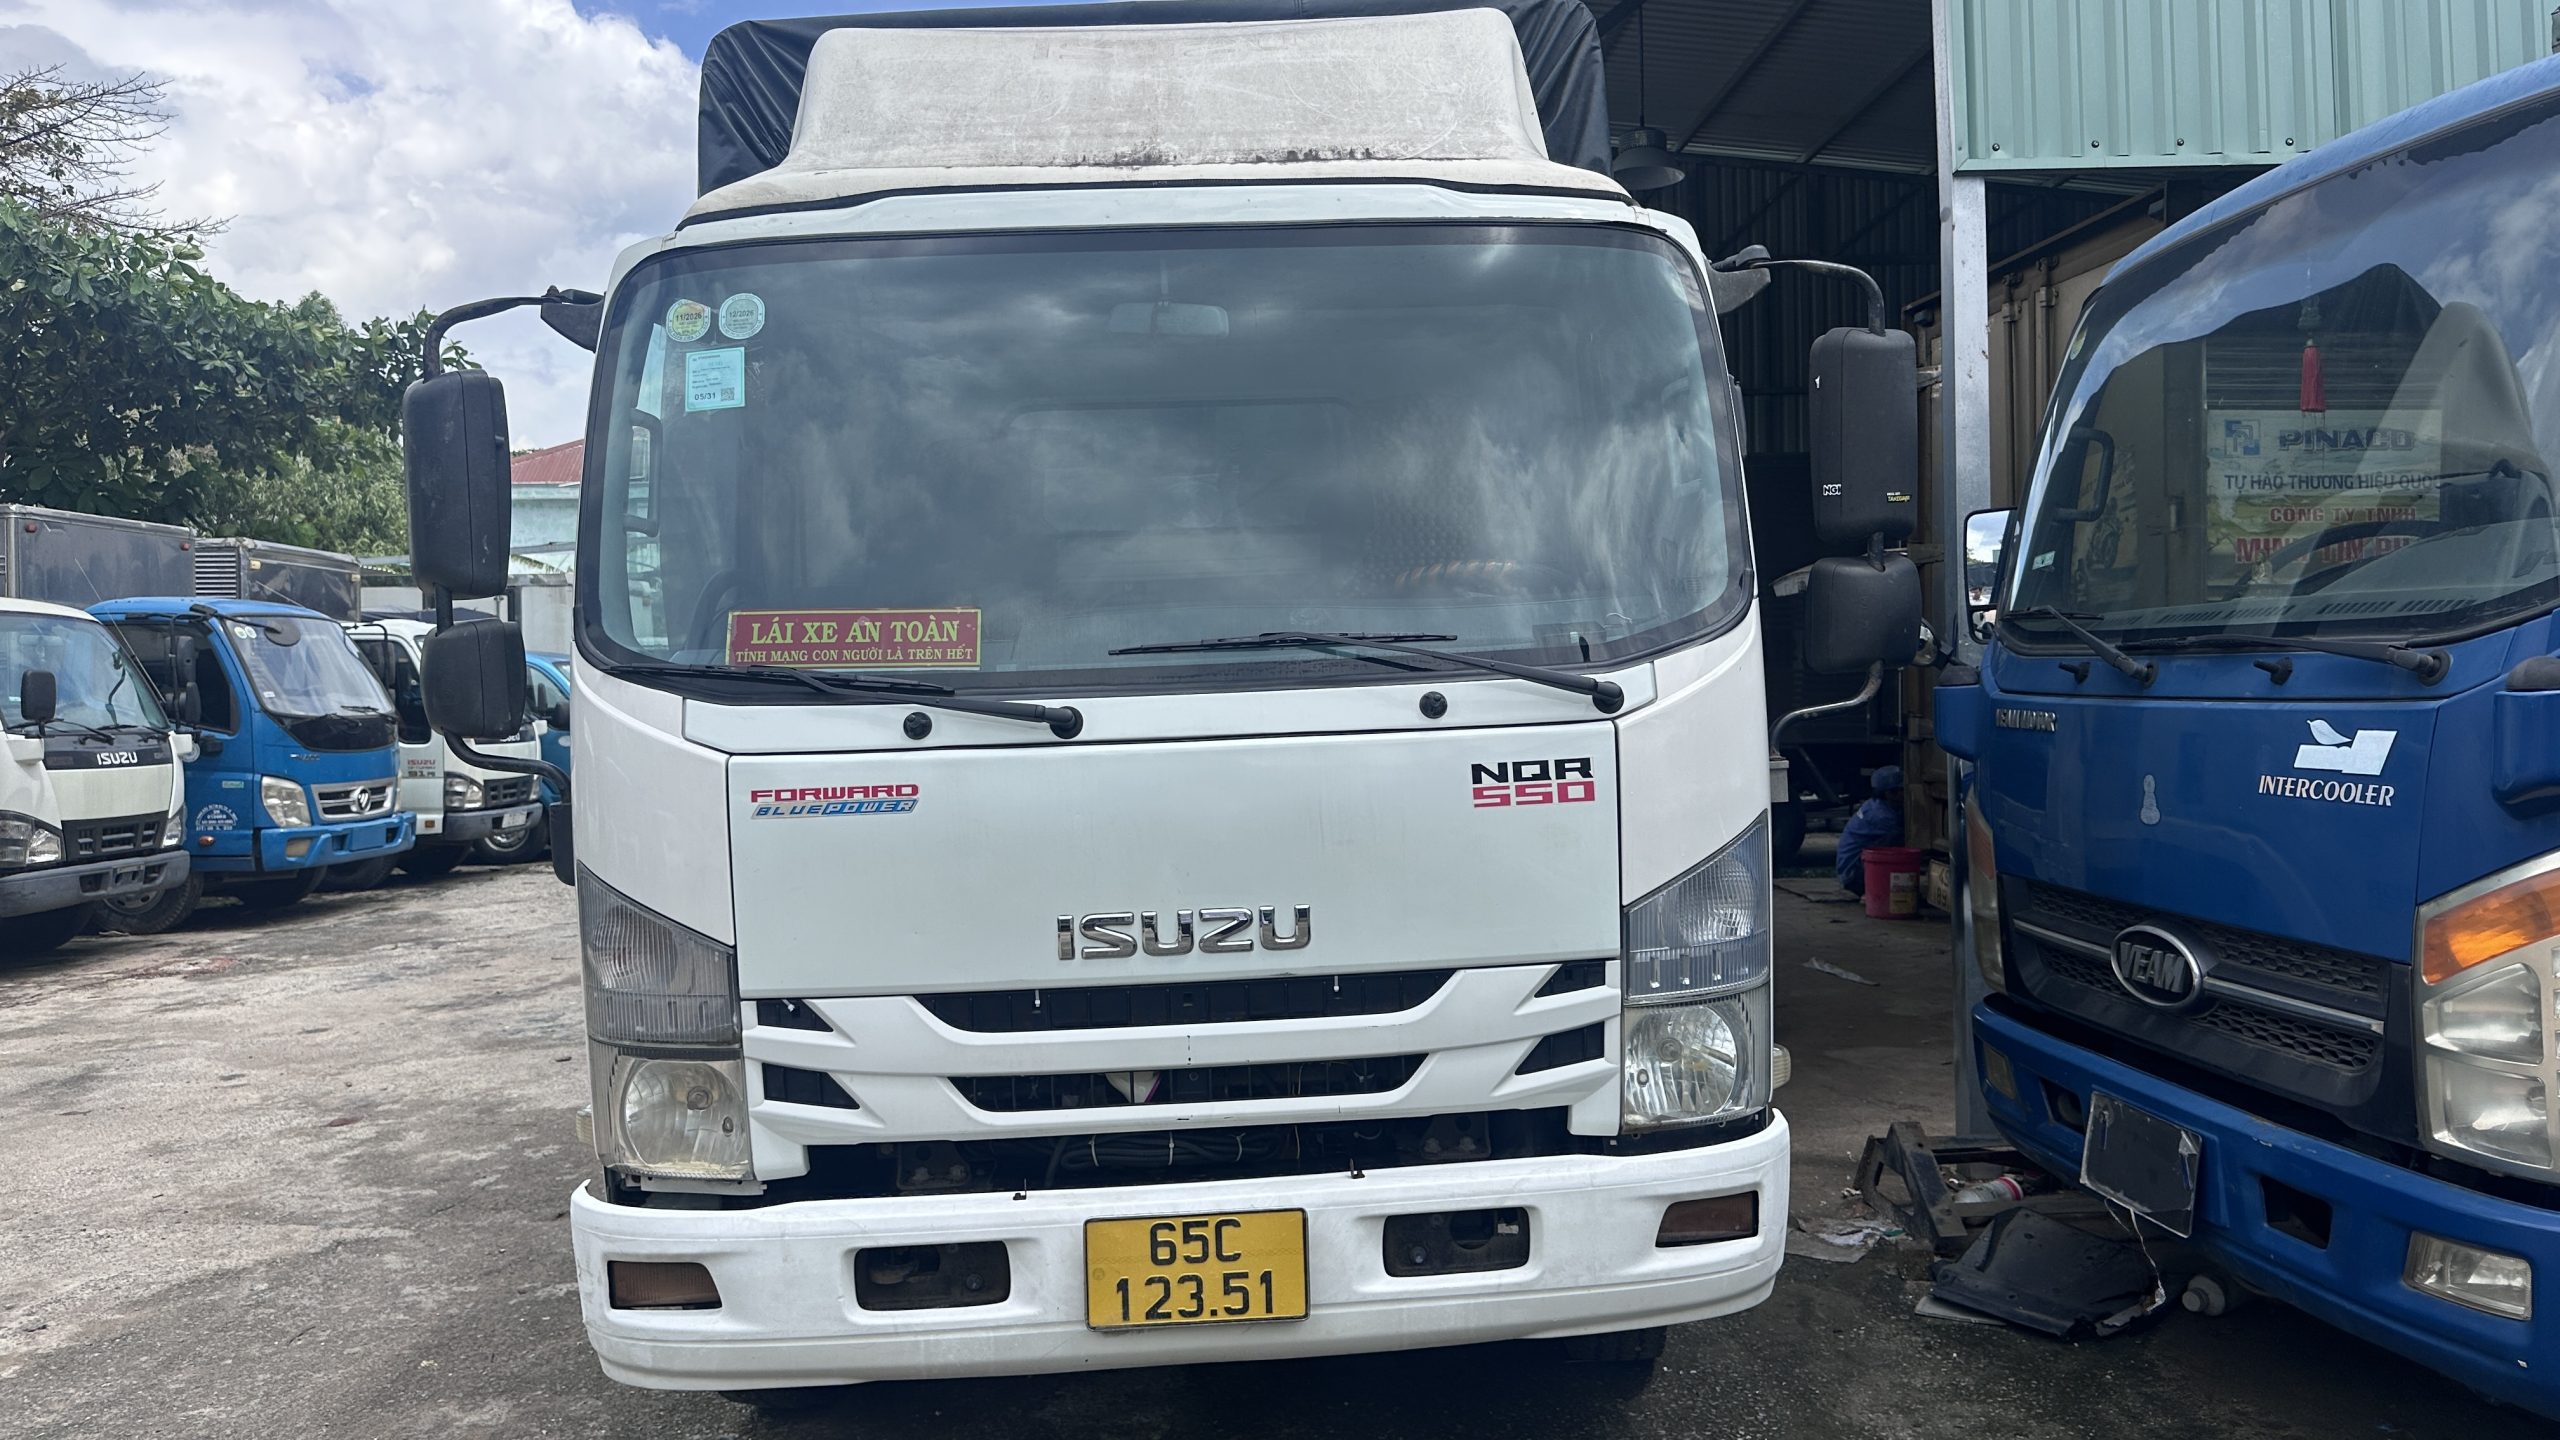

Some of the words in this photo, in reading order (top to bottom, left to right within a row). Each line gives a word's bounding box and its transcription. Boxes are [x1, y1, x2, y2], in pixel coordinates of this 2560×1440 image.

[694, 392, 716, 401] 05/31
[2279, 429, 2415, 450] PINACO
[2333, 505, 2360, 522] TY
[751, 616, 794, 644] LÁI
[801, 622, 838, 643] XE
[845, 621, 882, 643] AN
[890, 614, 960, 642] TOÀN
[736, 648, 766, 662] TÍNH
[770, 650, 808, 665] MẠNG
[812, 650, 838, 662] CON
[842, 646, 883, 661] NGƯỜI
[887, 645, 903, 660] LÀ
[908, 645, 942, 660] TRÊN
[947, 643, 973, 660] HẾT
[97, 751, 138, 765] ISUZU
[1471, 757, 1594, 785] NQR
[751, 784, 919, 803] FORWARD
[1472, 781, 1596, 808] 550
[2258, 775, 2395, 807] INTERCOOLER
[756, 799, 917, 817] BLUEPOWER
[1057, 904, 1311, 960] ISUZU
[2120, 941, 2185, 993] VEAM
[1149, 1218, 1242, 1266] 65C
[1116, 1270, 1274, 1321] 123.51
